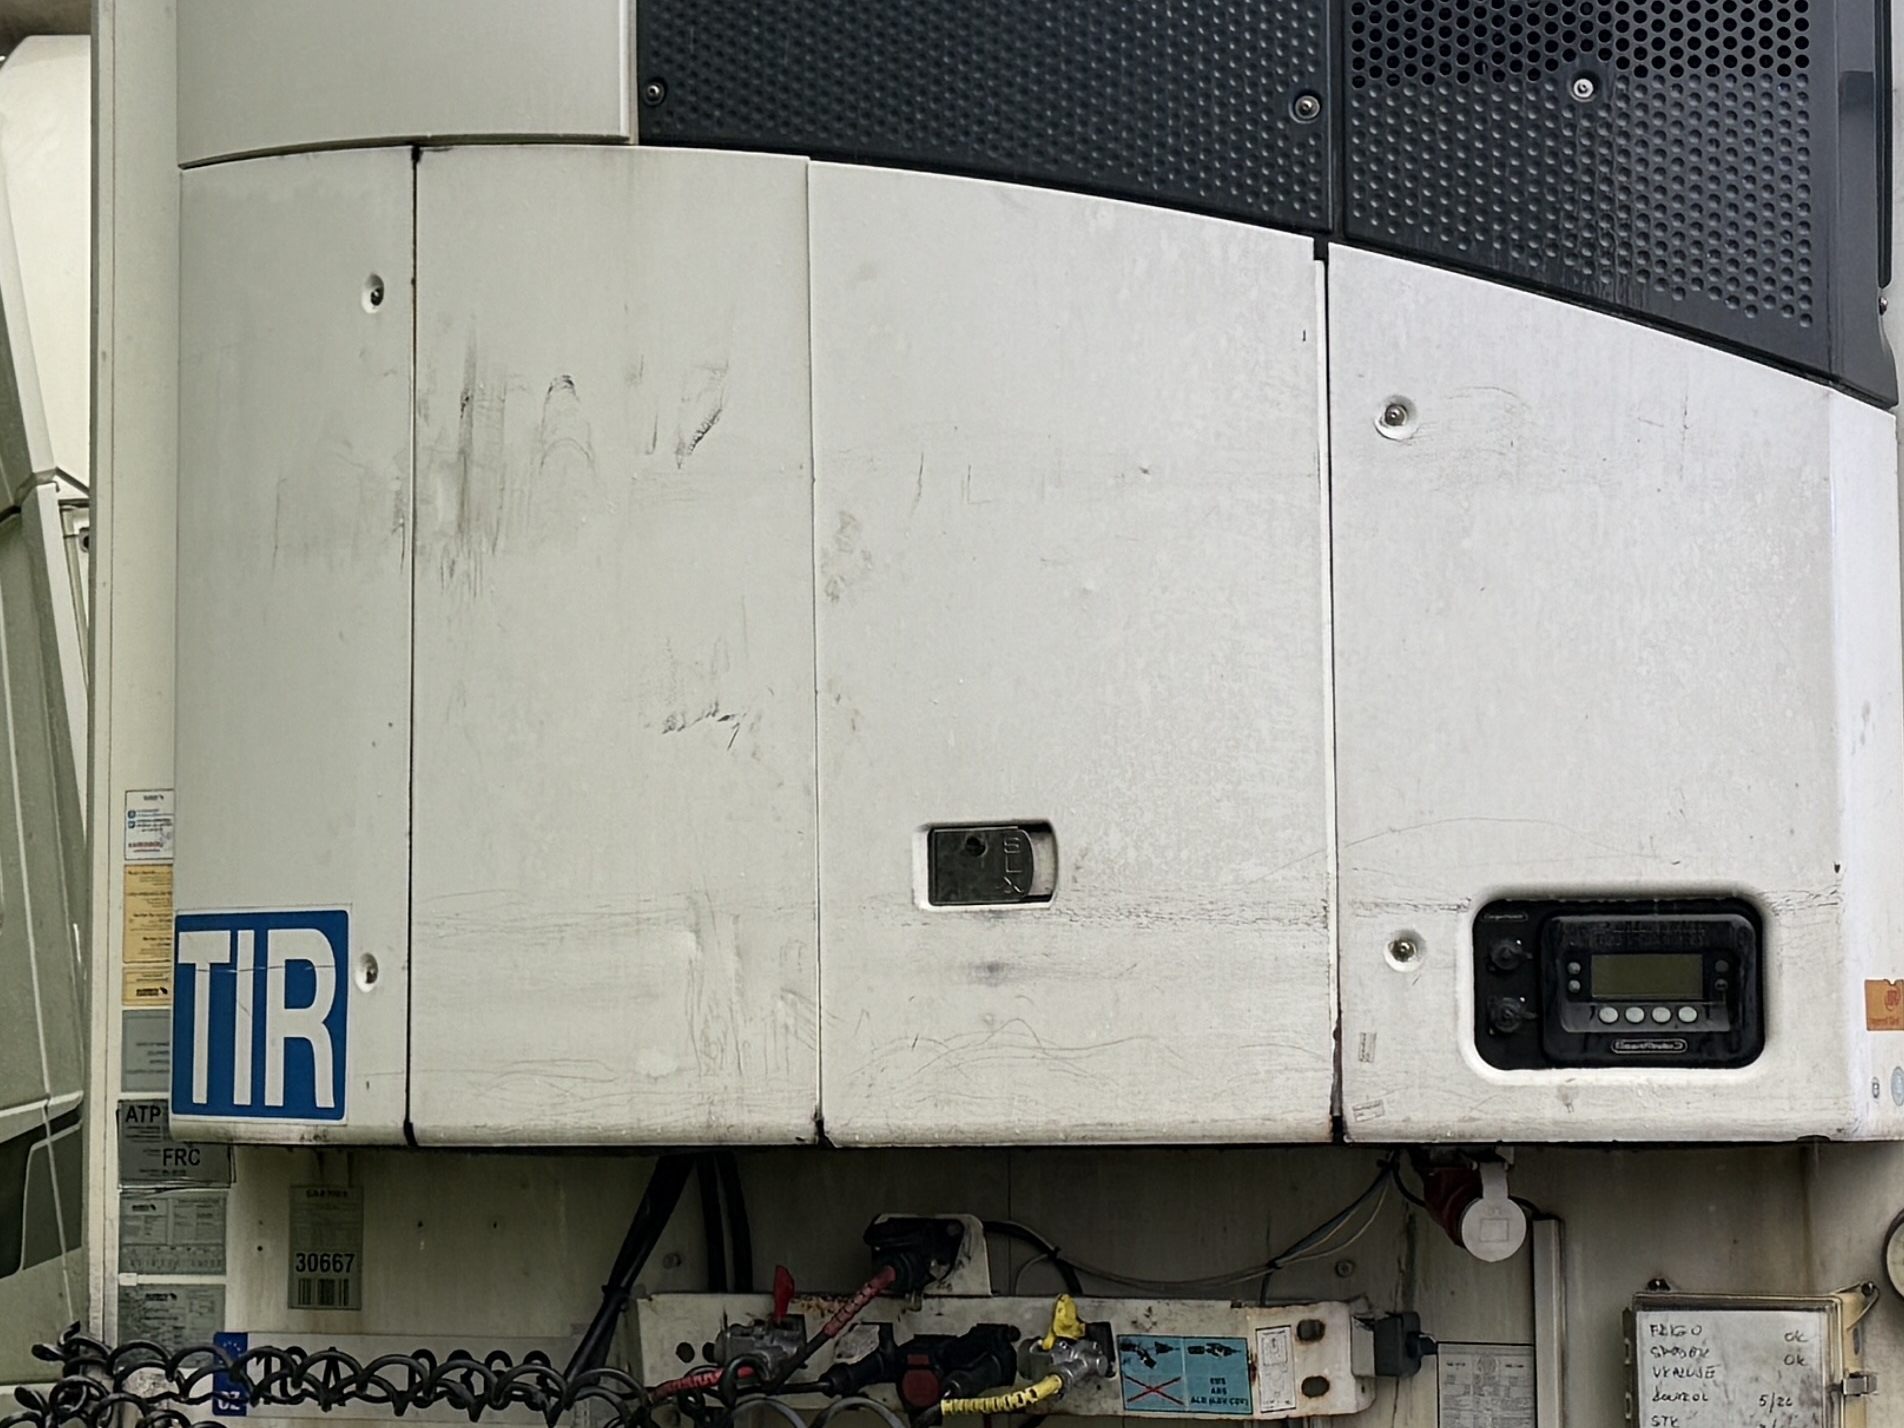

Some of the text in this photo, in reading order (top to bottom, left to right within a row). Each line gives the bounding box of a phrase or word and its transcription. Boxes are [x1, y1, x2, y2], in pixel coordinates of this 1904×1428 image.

[177, 928, 337, 1109] TIR
[125, 1105, 162, 1124] ATP
[162, 1148, 201, 1167] FRC
[295, 1253, 355, 1273] 30667
